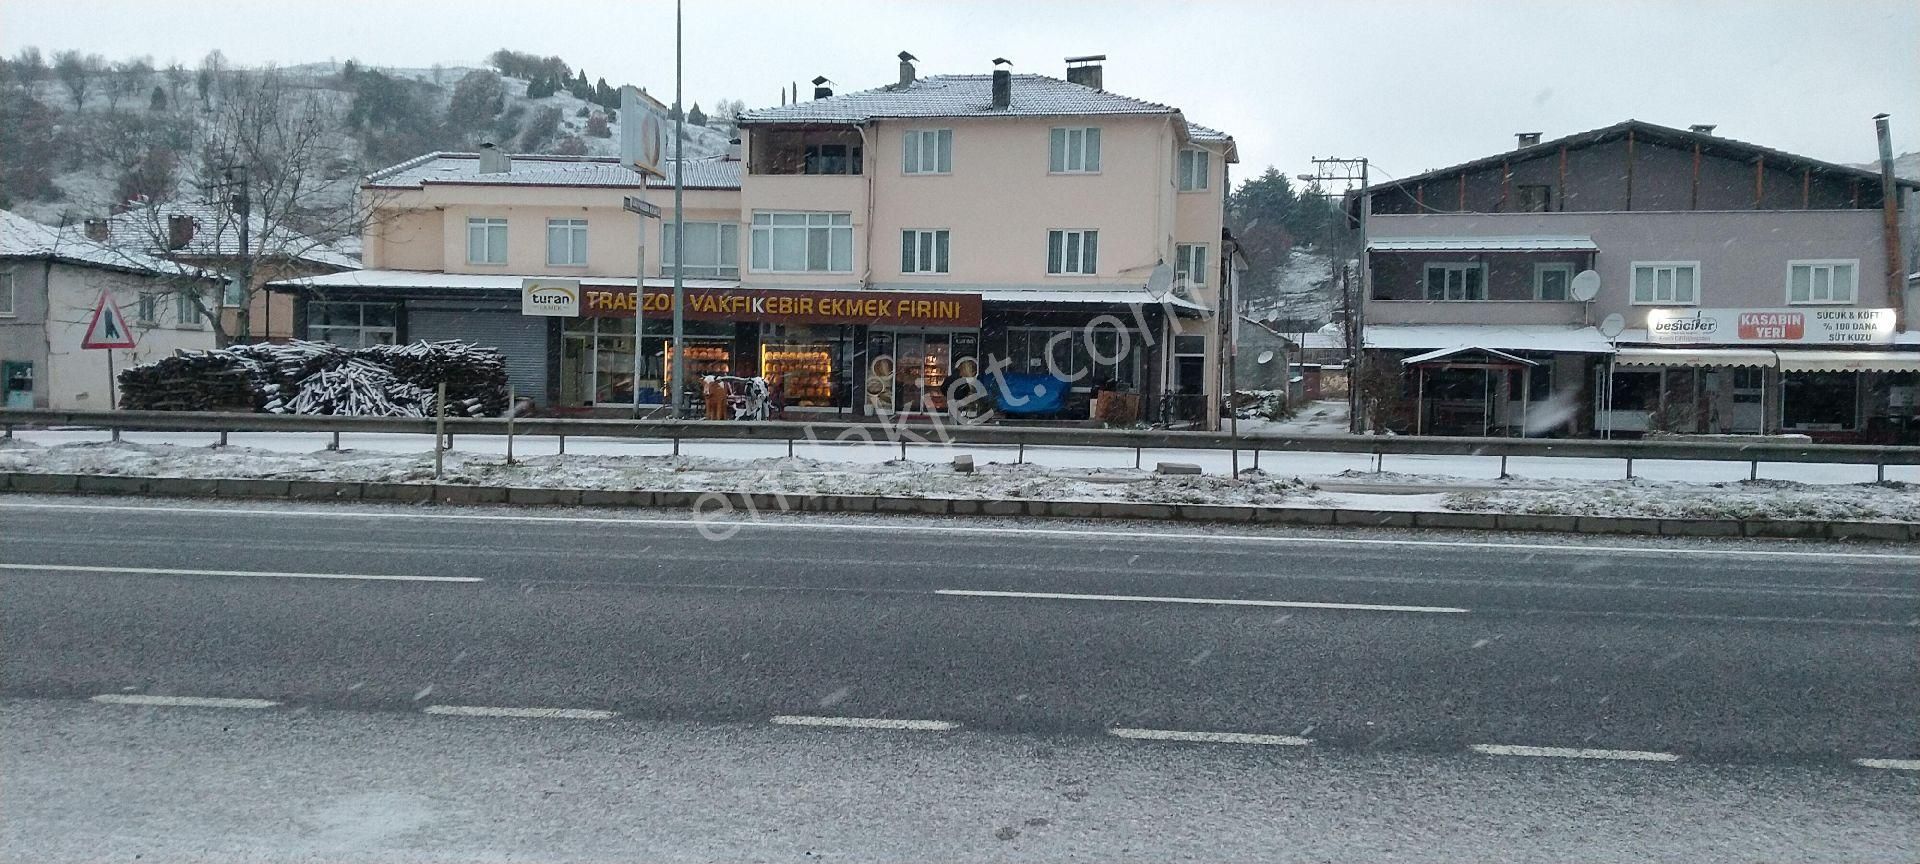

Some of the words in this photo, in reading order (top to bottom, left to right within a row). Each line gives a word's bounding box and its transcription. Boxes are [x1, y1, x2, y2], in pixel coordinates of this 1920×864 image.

[532, 293, 570, 304] turan
[587, 291, 683, 312] TRABZO
[818, 298, 892, 317] EKMEK
[897, 300, 961, 319] FIRINI
[1741, 313, 1800, 326] KASABIN
[1816, 311, 1846, 320] SUCUK
[1849, 311, 1855, 320] &
[1756, 324, 1786, 338] YERİ
[1835, 322, 1850, 331] 100
[1852, 322, 1877, 331] DANA
[1829, 332, 1845, 342] SÜT
[1847, 333, 1872, 342] KUZU
